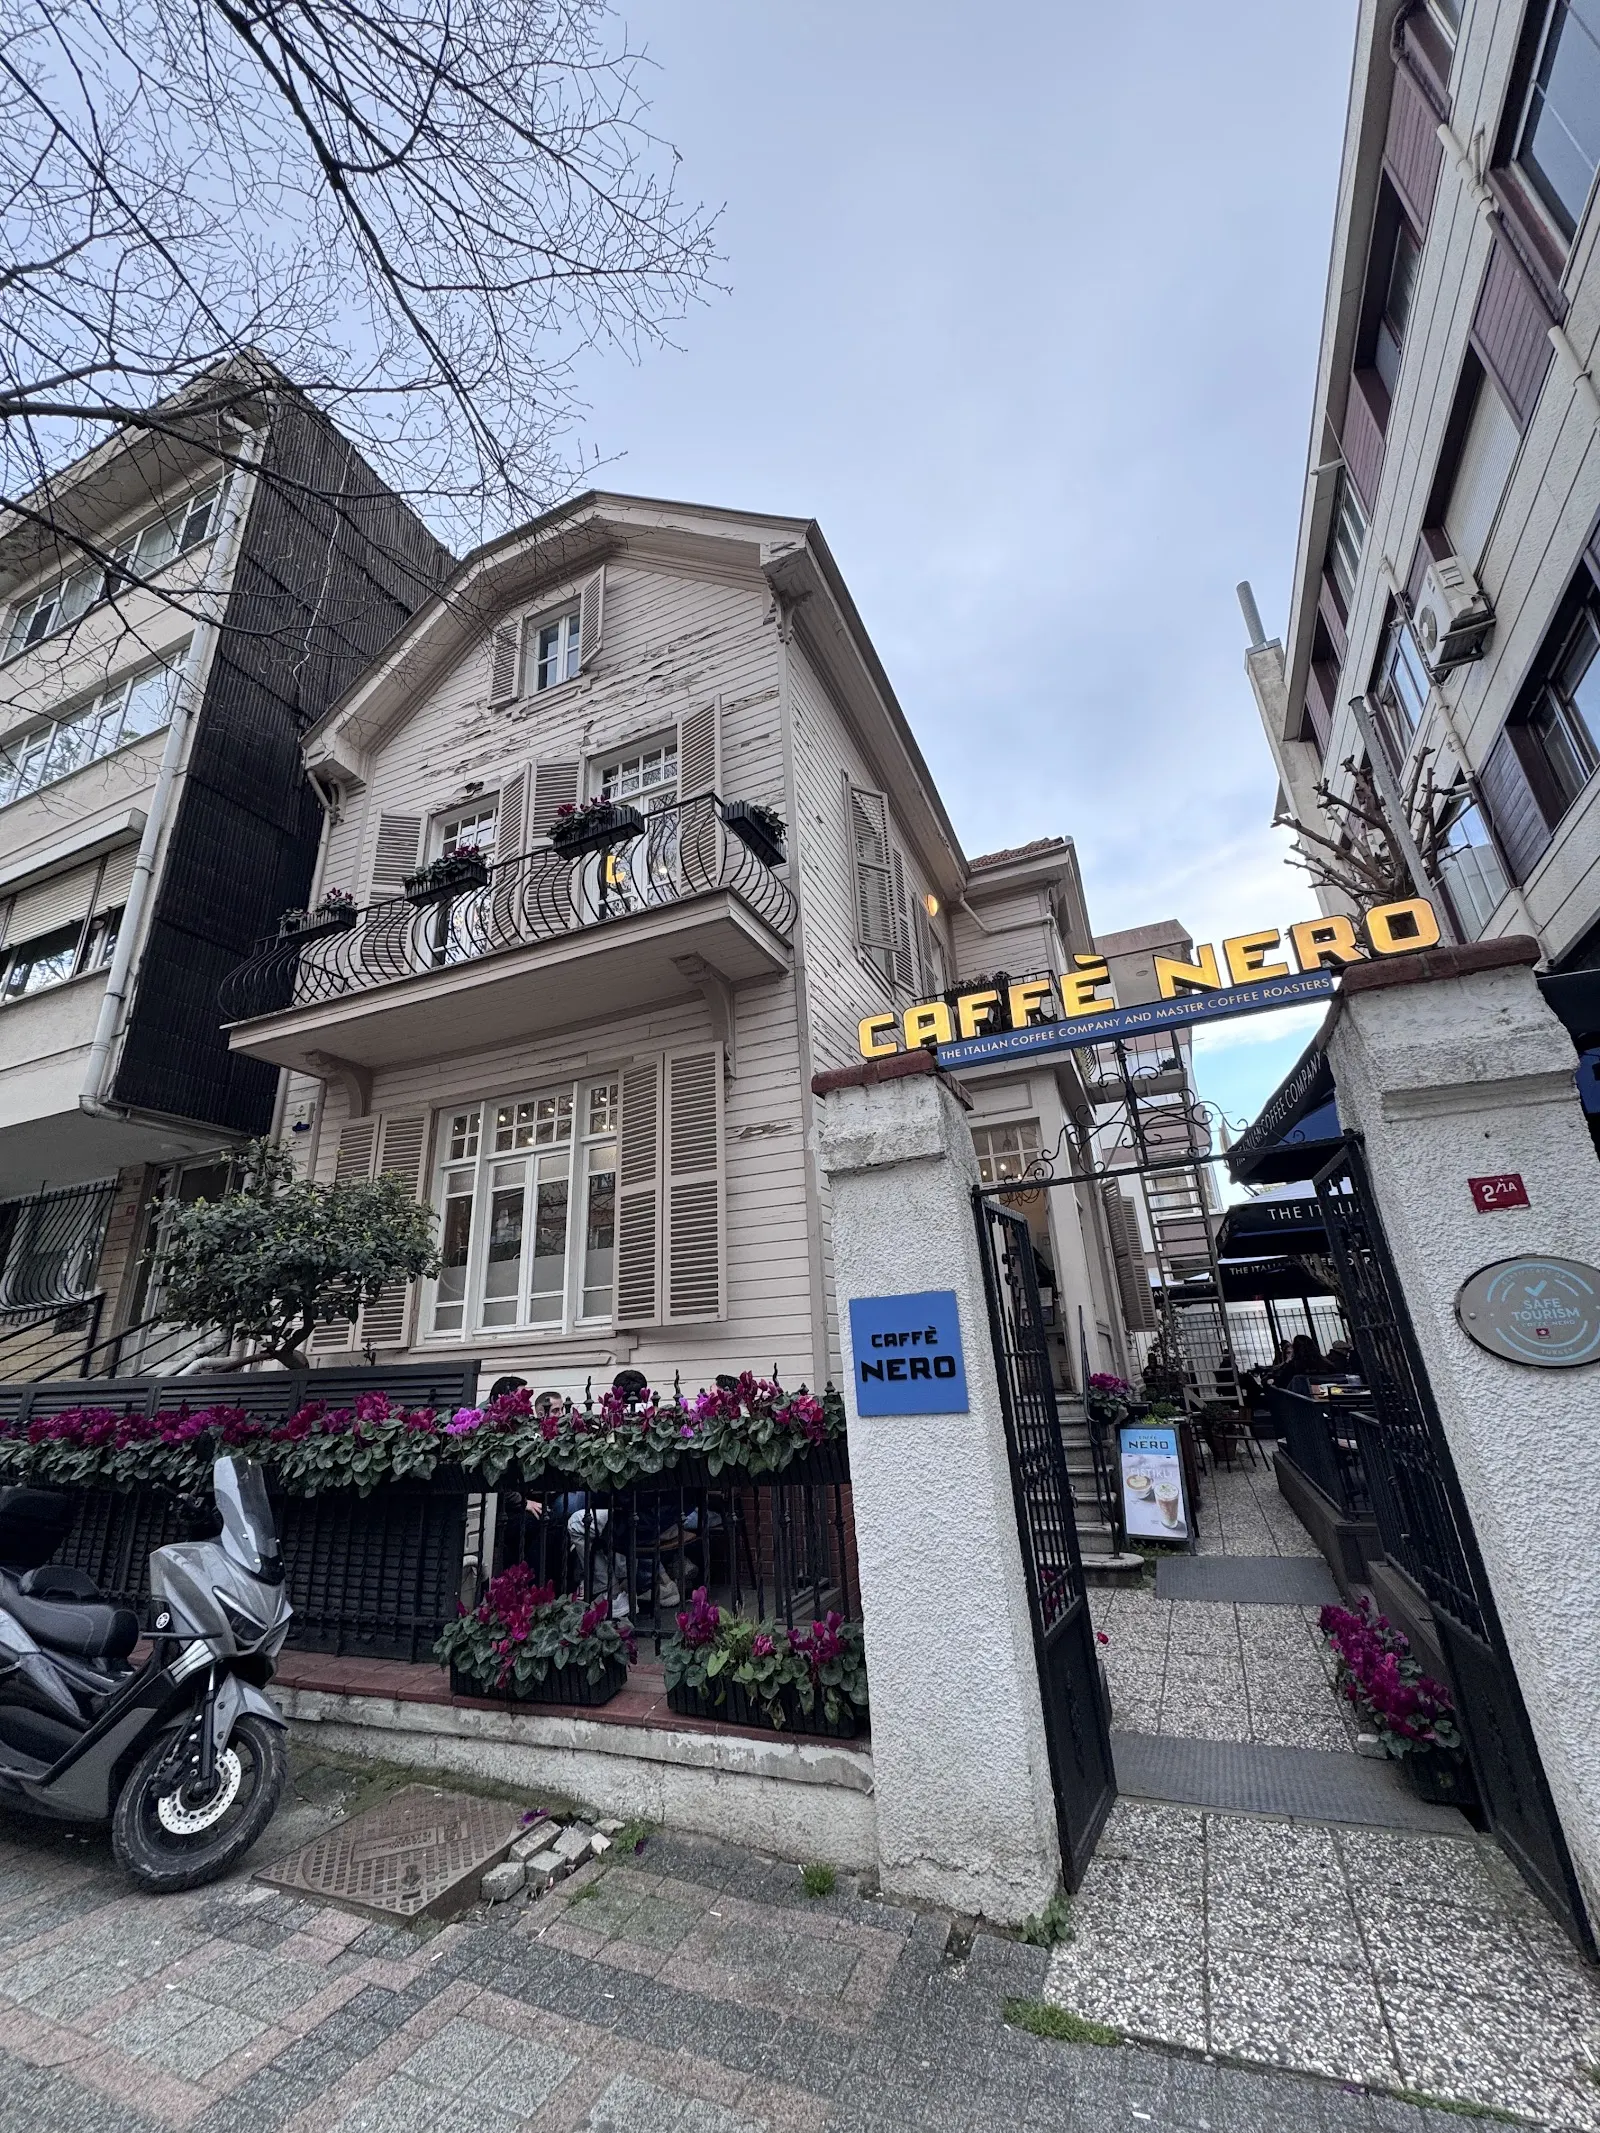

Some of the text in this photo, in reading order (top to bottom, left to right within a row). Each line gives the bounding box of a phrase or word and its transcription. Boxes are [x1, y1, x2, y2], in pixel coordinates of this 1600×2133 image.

[857, 898, 1441, 1060] CAFFÈ NERO
[941, 977, 1330, 1060] THE ITALIAN COFFEE COMPANY AND MASTER COFFEE ROASTERS
[1261, 1097, 1287, 1136] COFFEE
[1284, 1050, 1321, 1109] COMPANY
[1266, 1205, 1303, 1221] THE
[1229, 1266, 1249, 1276] THE
[1523, 1298, 1561, 1310] SAFE
[1511, 1307, 1580, 1321] TOURISM
[871, 1325, 938, 1348] CAFFÈ
[861, 1355, 956, 1382] NERO
[1128, 1440, 1169, 1450] NERO
